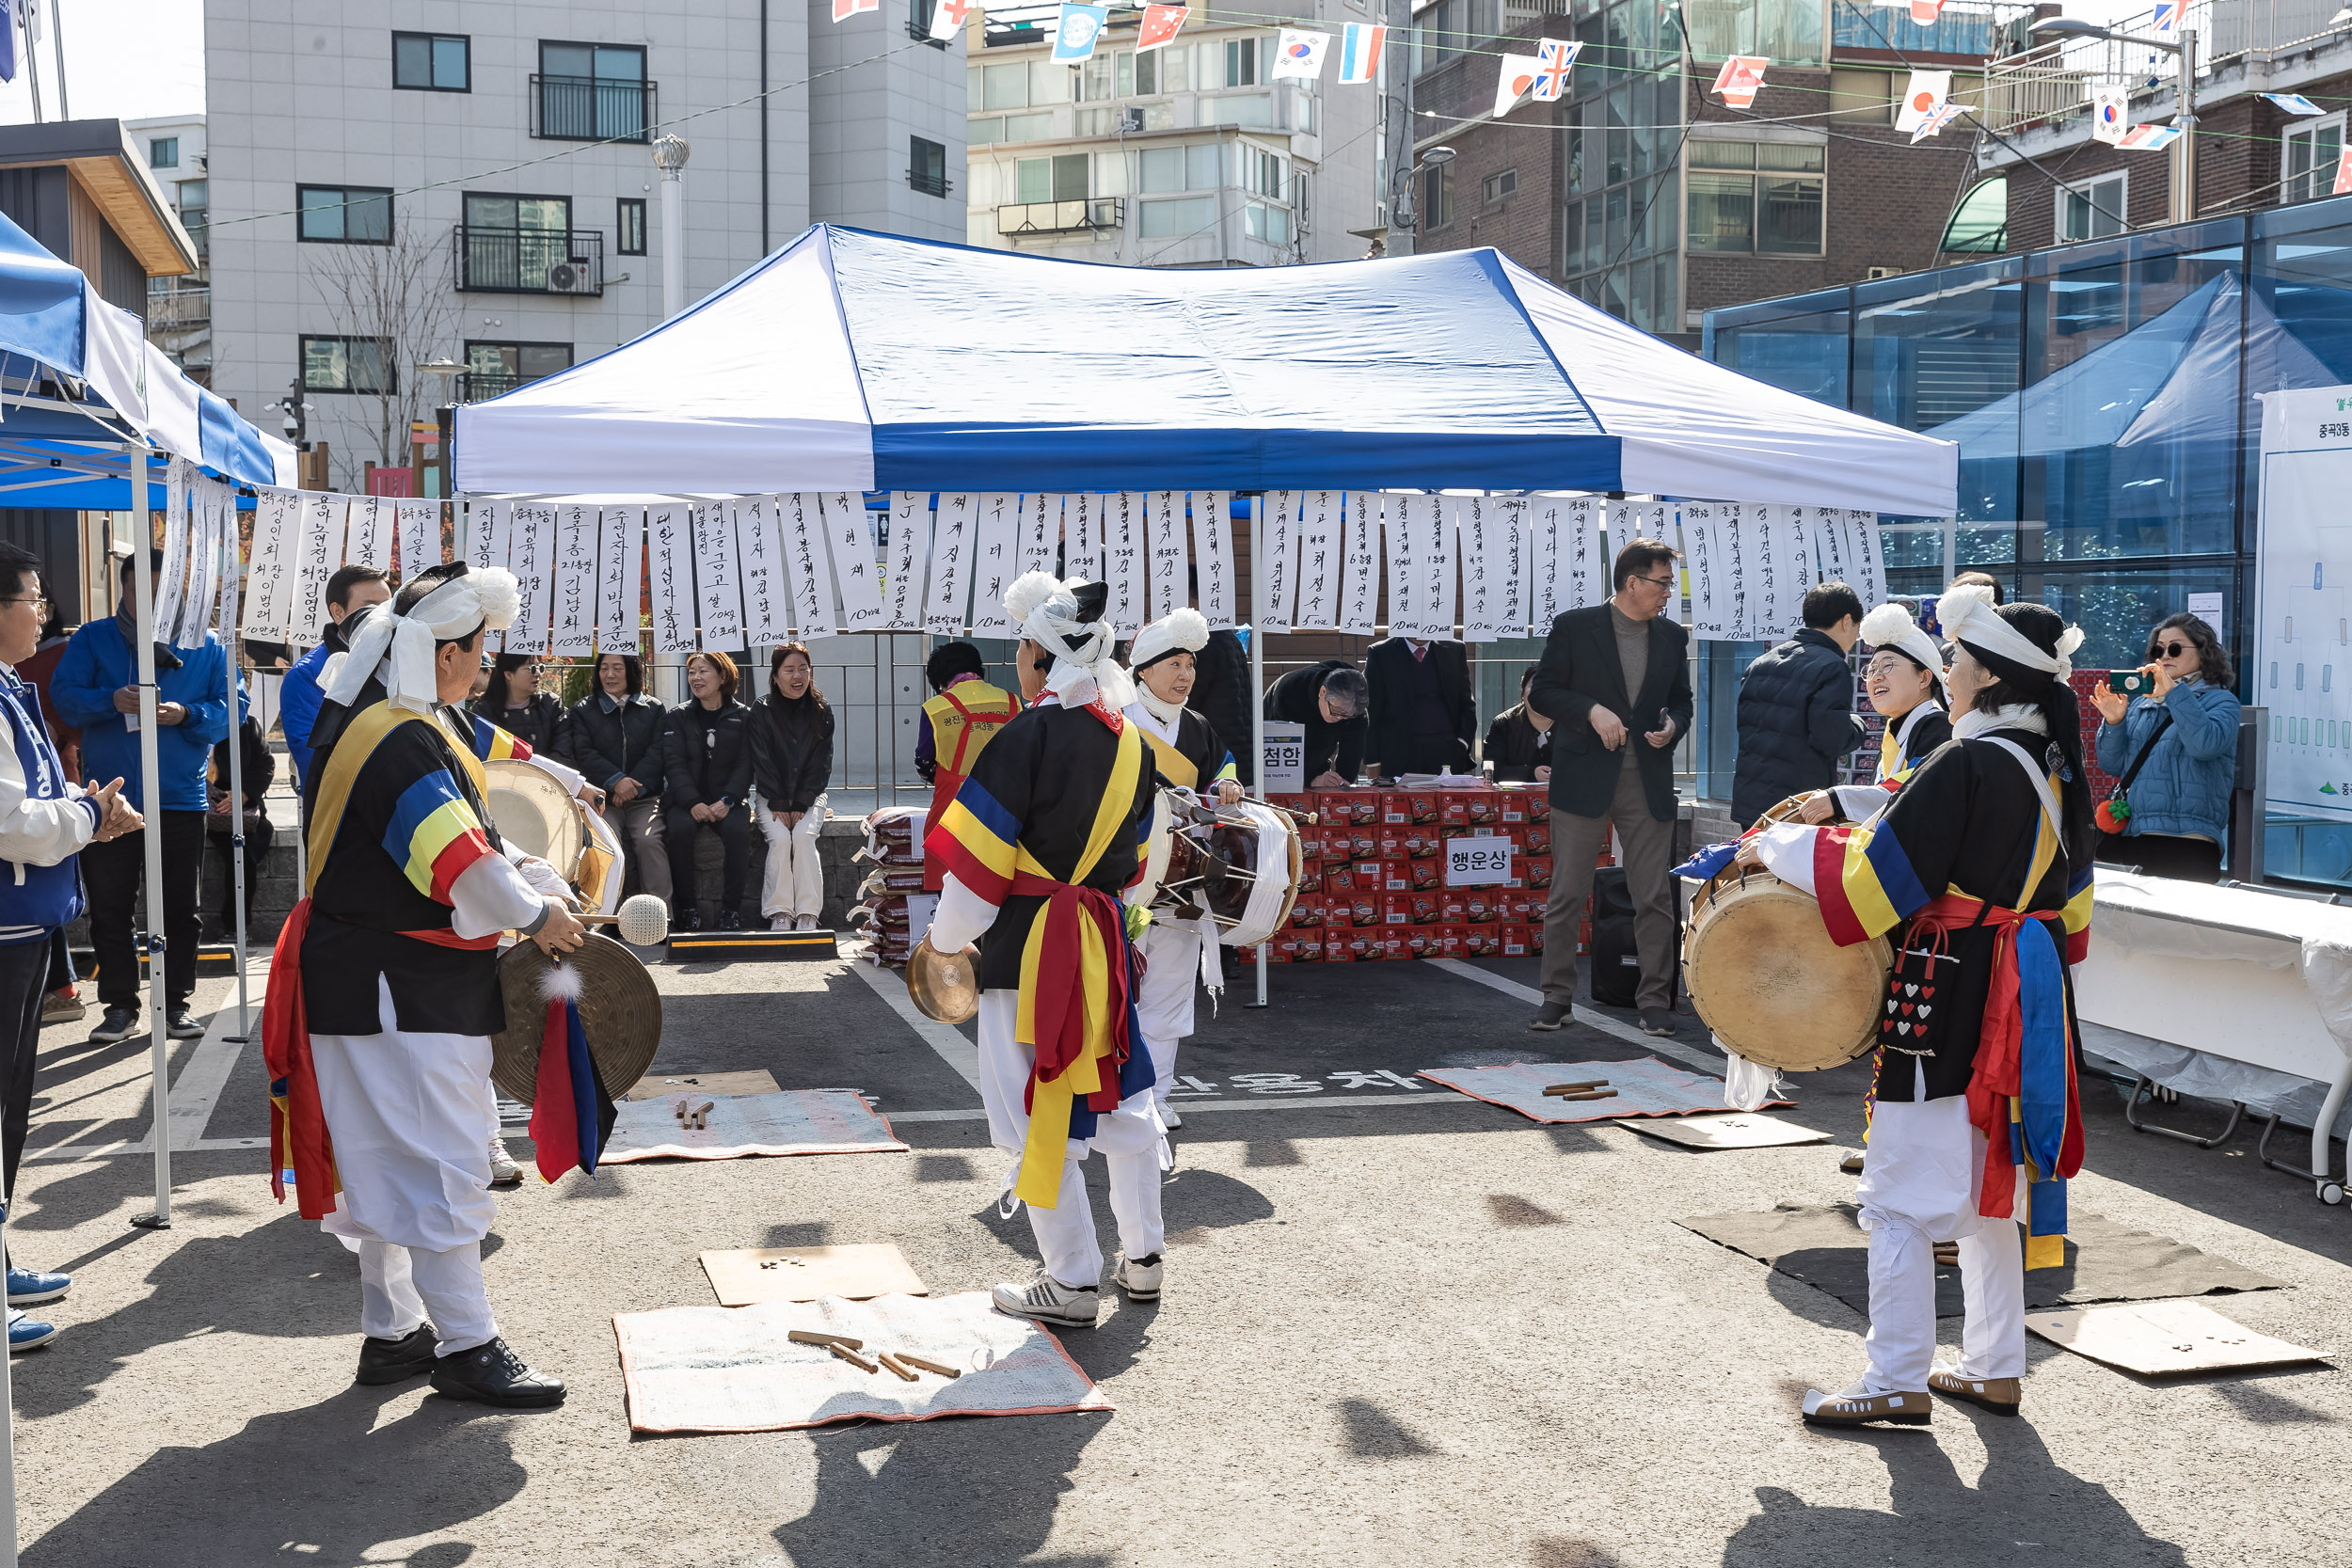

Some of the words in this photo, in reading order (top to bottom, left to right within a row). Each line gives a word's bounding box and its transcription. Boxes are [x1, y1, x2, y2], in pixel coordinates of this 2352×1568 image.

[2319, 422, 2350, 438] 중곡3동
[245, 626, 279, 637] 10만원
[509, 640, 546, 652] 10만원
[556, 633, 593, 647] 10만원
[1452, 850, 1507, 872] 행운상
